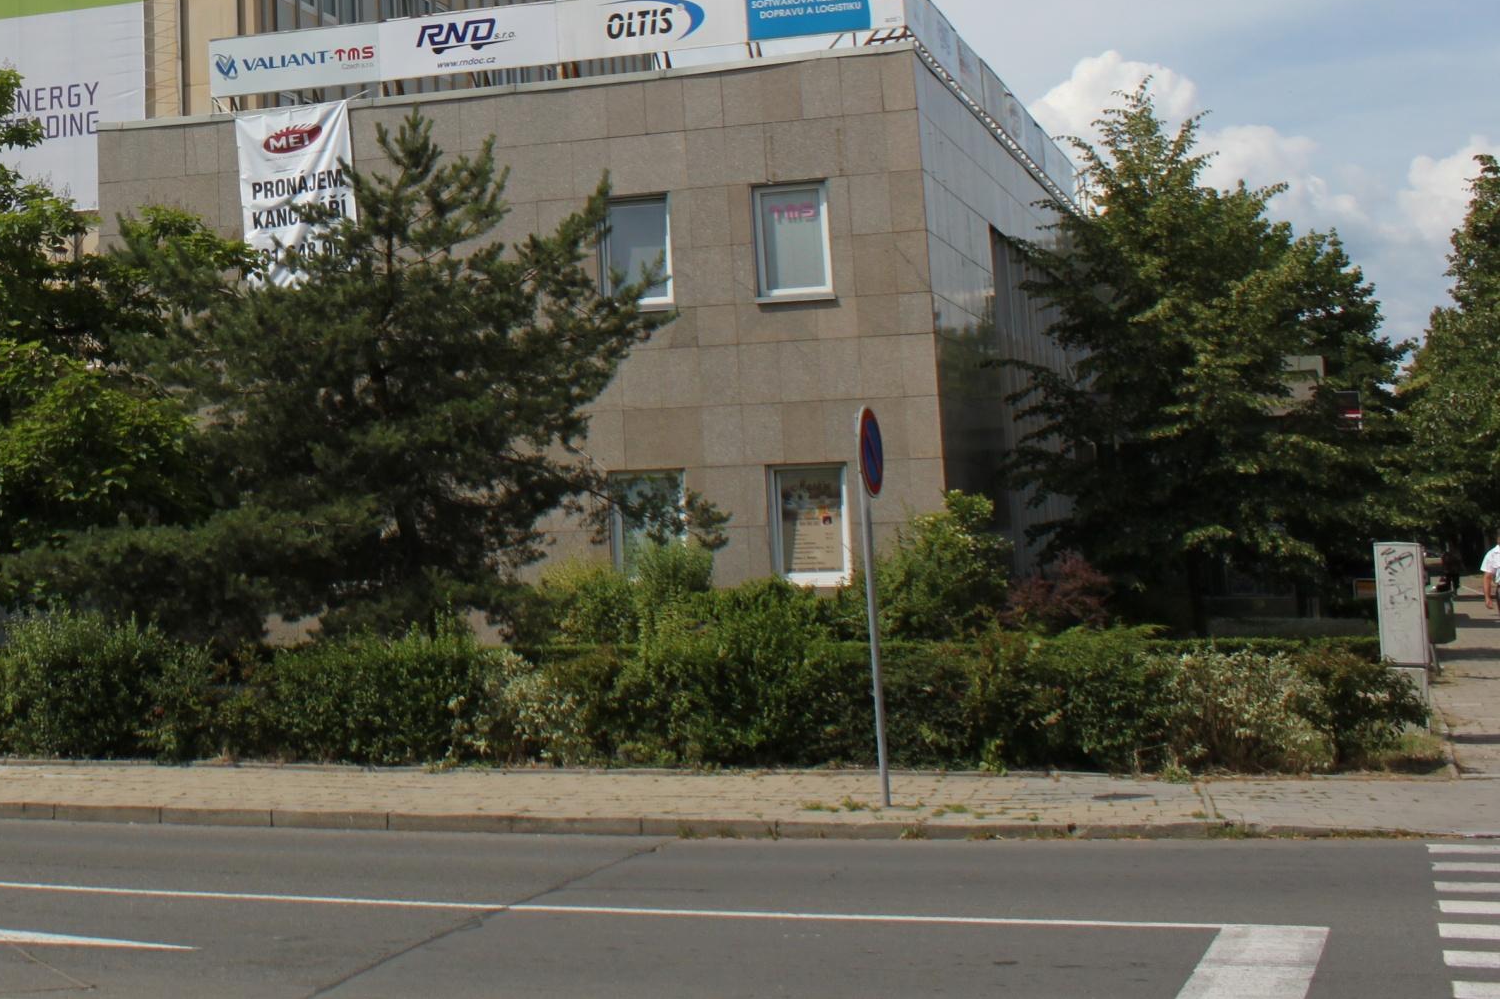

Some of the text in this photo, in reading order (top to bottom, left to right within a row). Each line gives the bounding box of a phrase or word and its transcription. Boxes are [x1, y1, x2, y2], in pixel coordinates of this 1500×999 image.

[606, 8, 673, 40] OLTIS
[759, 1, 862, 19] DOPRAVU A LOGISTIKU
[416, 18, 517, 48] RND s.r.o.
[12, 81, 100, 113] NERGY
[269, 132, 311, 152] MEI
[251, 168, 343, 200] PRONÁJEM
